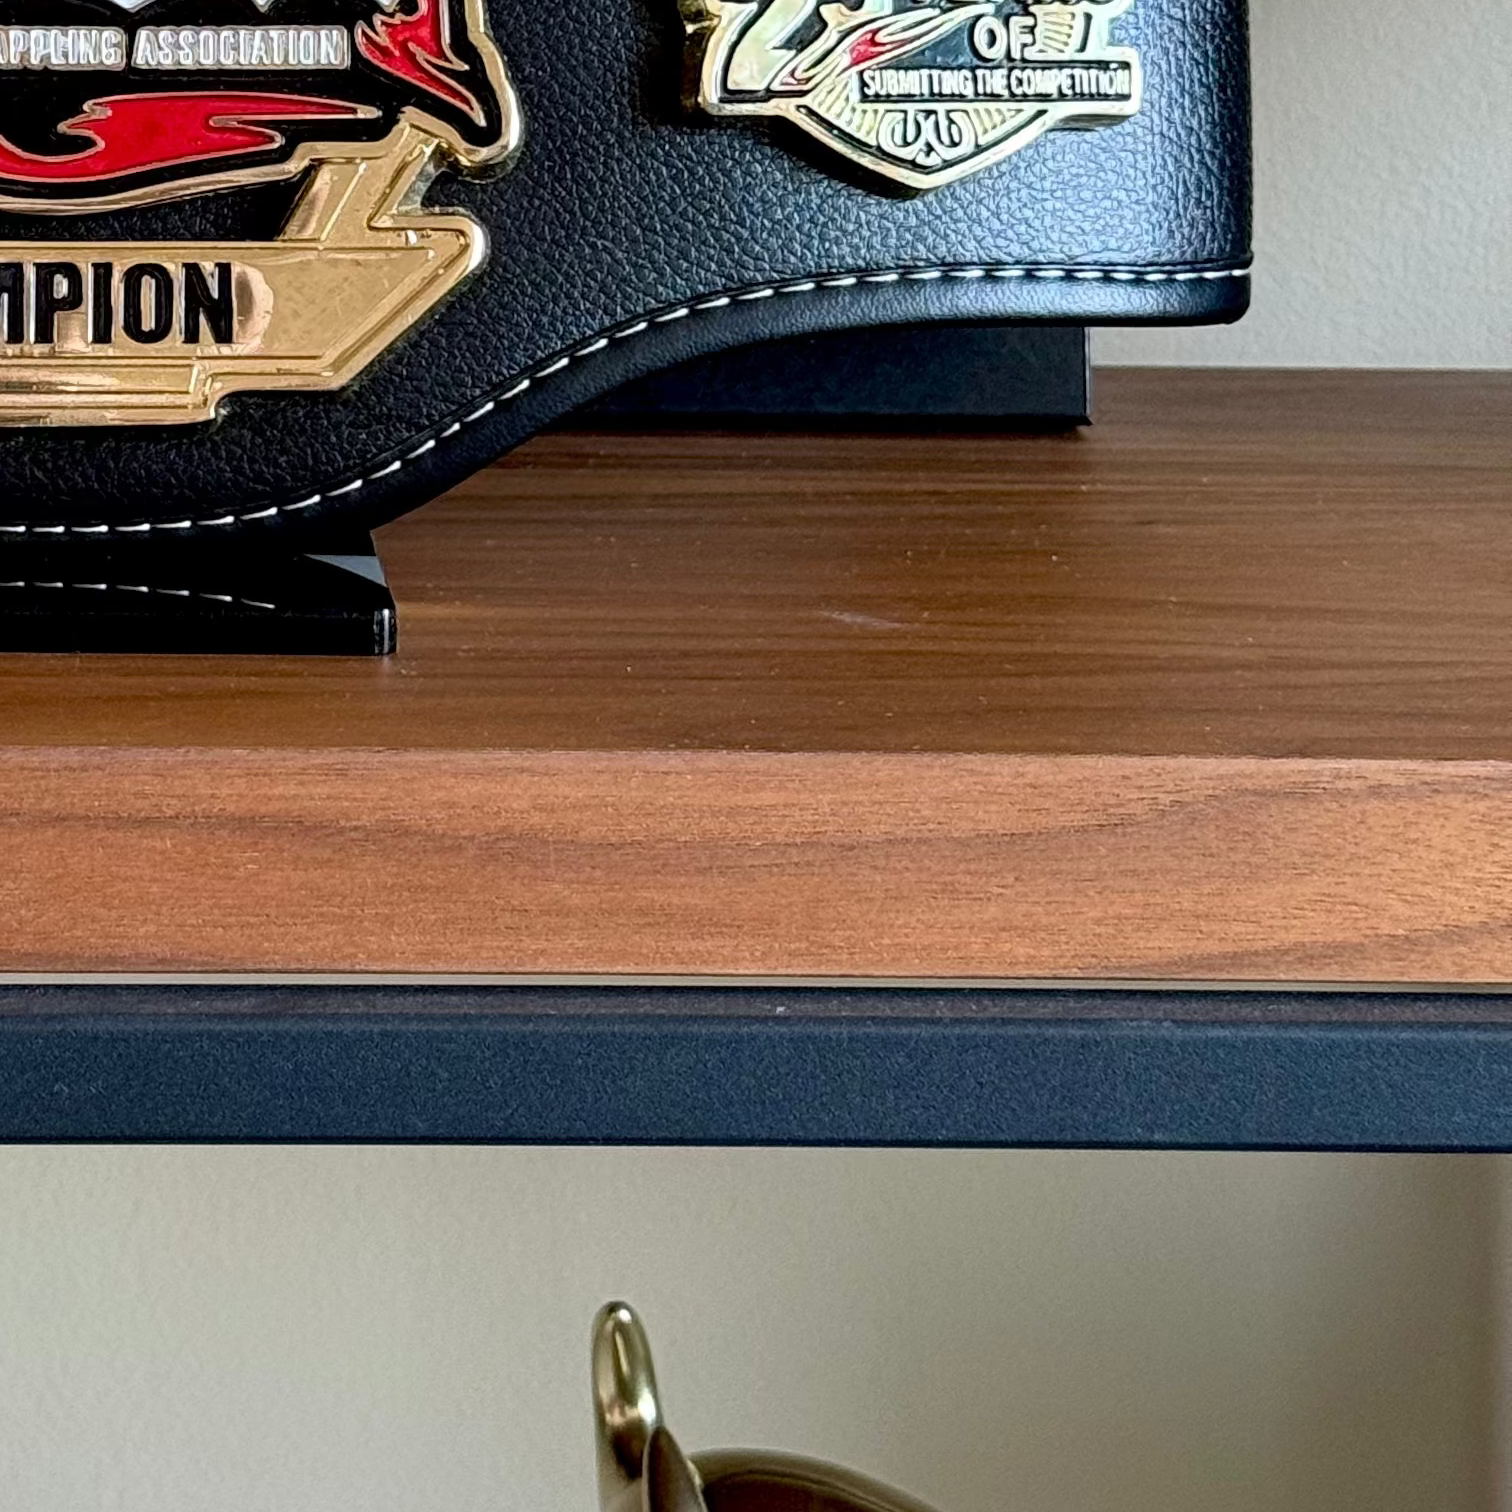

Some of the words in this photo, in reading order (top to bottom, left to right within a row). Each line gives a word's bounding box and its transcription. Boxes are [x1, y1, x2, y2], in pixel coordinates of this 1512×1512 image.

[134, 28, 345, 66] ASSOCIATION
[973, 12, 1037, 61] OF
[861, 68, 974, 98] SUBMITTING
[974, 68, 1009, 98] THE
[1009, 66, 1131, 98] COMPETITION
